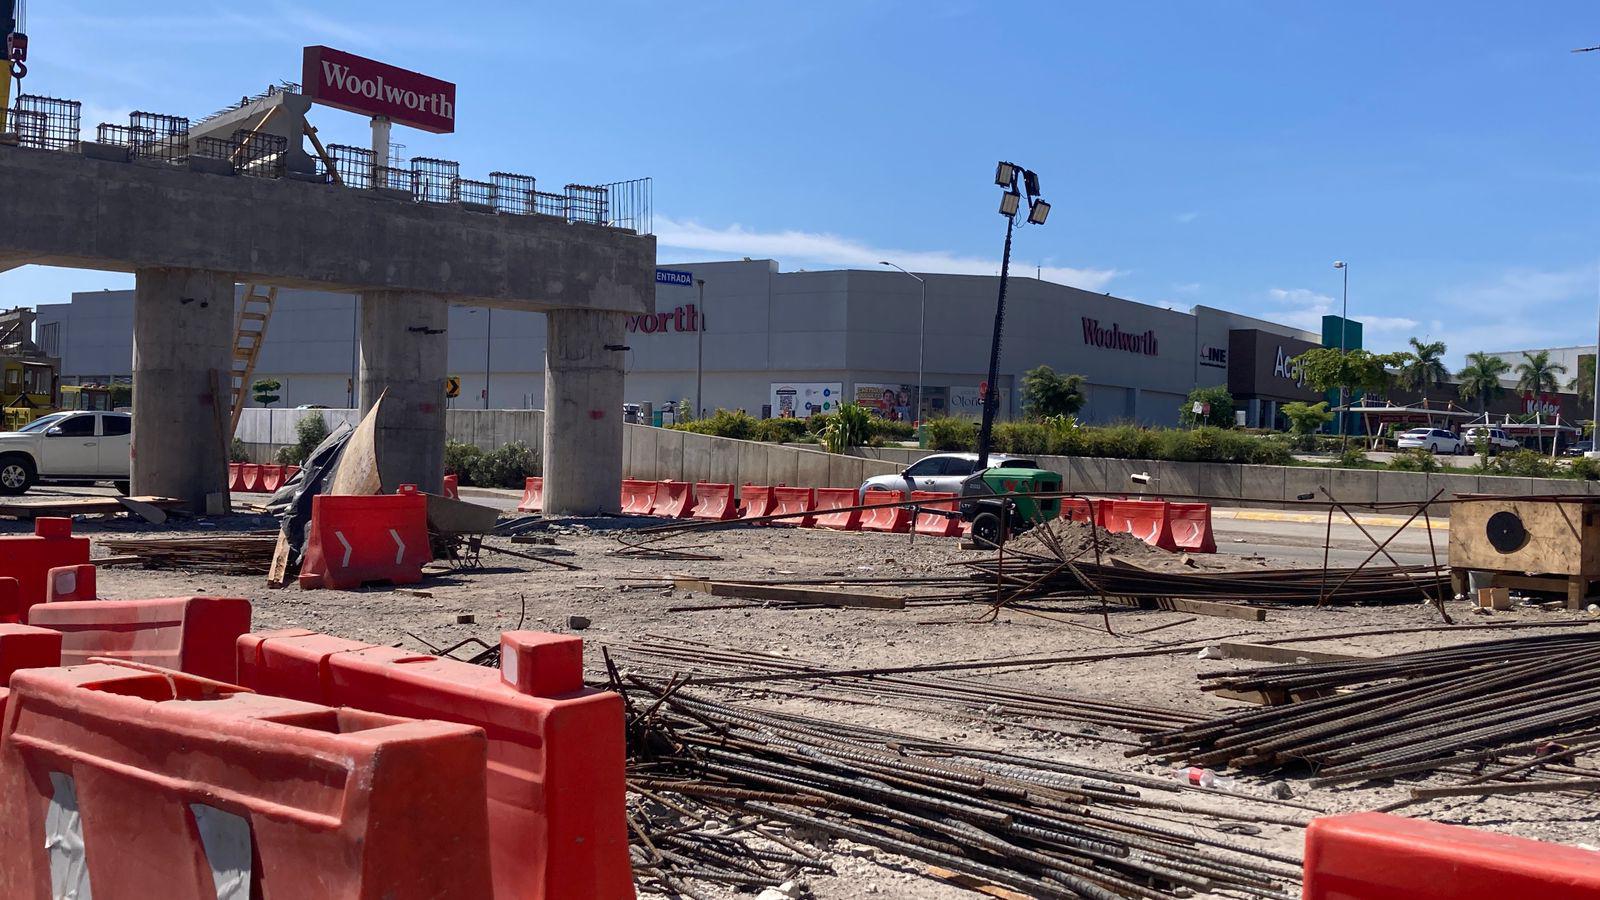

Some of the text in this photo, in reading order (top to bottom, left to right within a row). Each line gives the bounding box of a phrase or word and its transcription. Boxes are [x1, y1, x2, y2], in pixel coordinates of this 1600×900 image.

[321, 60, 453, 120] Woolworth
[656, 272, 691, 284] ENTRADA
[1081, 316, 1159, 357] Woolworth
[1208, 347, 1226, 363] INE
[1273, 345, 1307, 389] Acay
